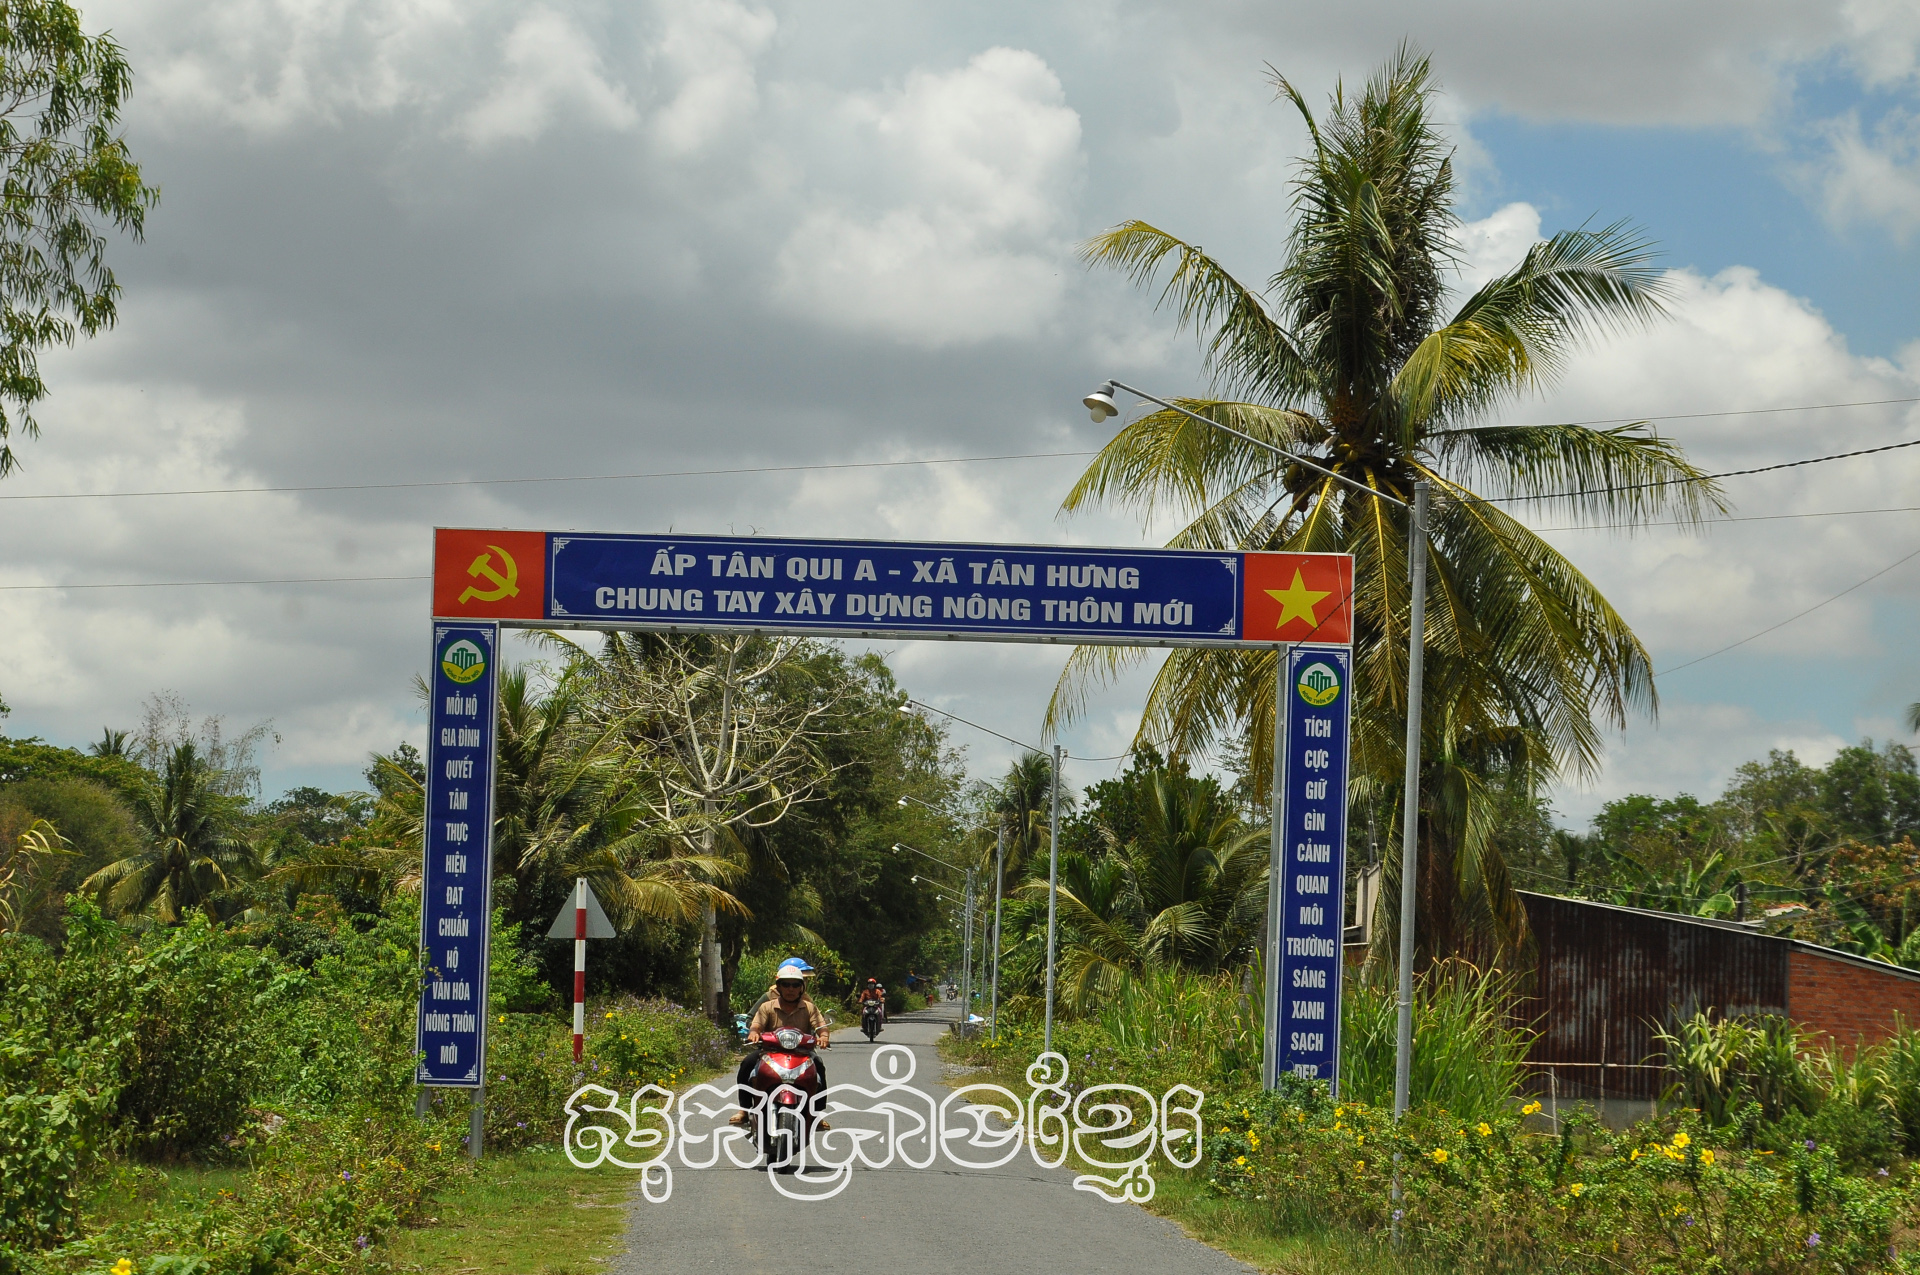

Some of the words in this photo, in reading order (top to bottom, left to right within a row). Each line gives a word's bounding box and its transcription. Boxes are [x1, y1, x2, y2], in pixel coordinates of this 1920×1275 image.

[651, 546, 696, 576] ẤP
[708, 551, 774, 578] TÂN
[786, 558, 842, 582] QUI
[854, 559, 877, 581] A
[912, 558, 958, 584] XÃ
[969, 559, 1034, 586] TÂN
[1047, 564, 1139, 589] HƯNG
[595, 586, 703, 611] CHUNG
[714, 591, 764, 612] TAY
[774, 588, 836, 614] XÂY
[847, 592, 932, 621] DỰNG
[943, 593, 1031, 621] NÔNG
[1041, 597, 1122, 623] THÔN
[1133, 599, 1193, 626] MỚI
[446, 691, 463, 715] MỖI
[466, 694, 477, 720] HỘ
[442, 729, 456, 746] GIA
[458, 725, 479, 747] ĐÌNH
[1305, 715, 1331, 738] TÍCH
[446, 755, 473, 779] QUYẾT
[1305, 749, 1328, 772] CỰC
[449, 788, 467, 810] TÂM
[1306, 778, 1327, 799] GIỮ
[1304, 809, 1325, 831] GÌN
[446, 823, 468, 845] THỰC
[1297, 838, 1330, 863] CẢNH
[446, 851, 466, 877] HIỆN
[1296, 875, 1328, 895] QUAN
[446, 887, 463, 909] ĐẠT
[439, 911, 468, 937] CHUẨN
[1300, 903, 1323, 925] MÔI
[1287, 933, 1334, 957] TRƯỜNG
[447, 946, 458, 972] HỘ
[1293, 966, 1325, 988] SÁNG
[432, 978, 450, 1000] VĂN
[453, 978, 470, 1000] HÓA
[426, 1010, 450, 1032] NÔNG
[452, 1011, 474, 1032] THÔN
[1292, 1001, 1324, 1020] XANH
[440, 1042, 457, 1064] MỚI
[1291, 1032, 1323, 1055] SẠCH
